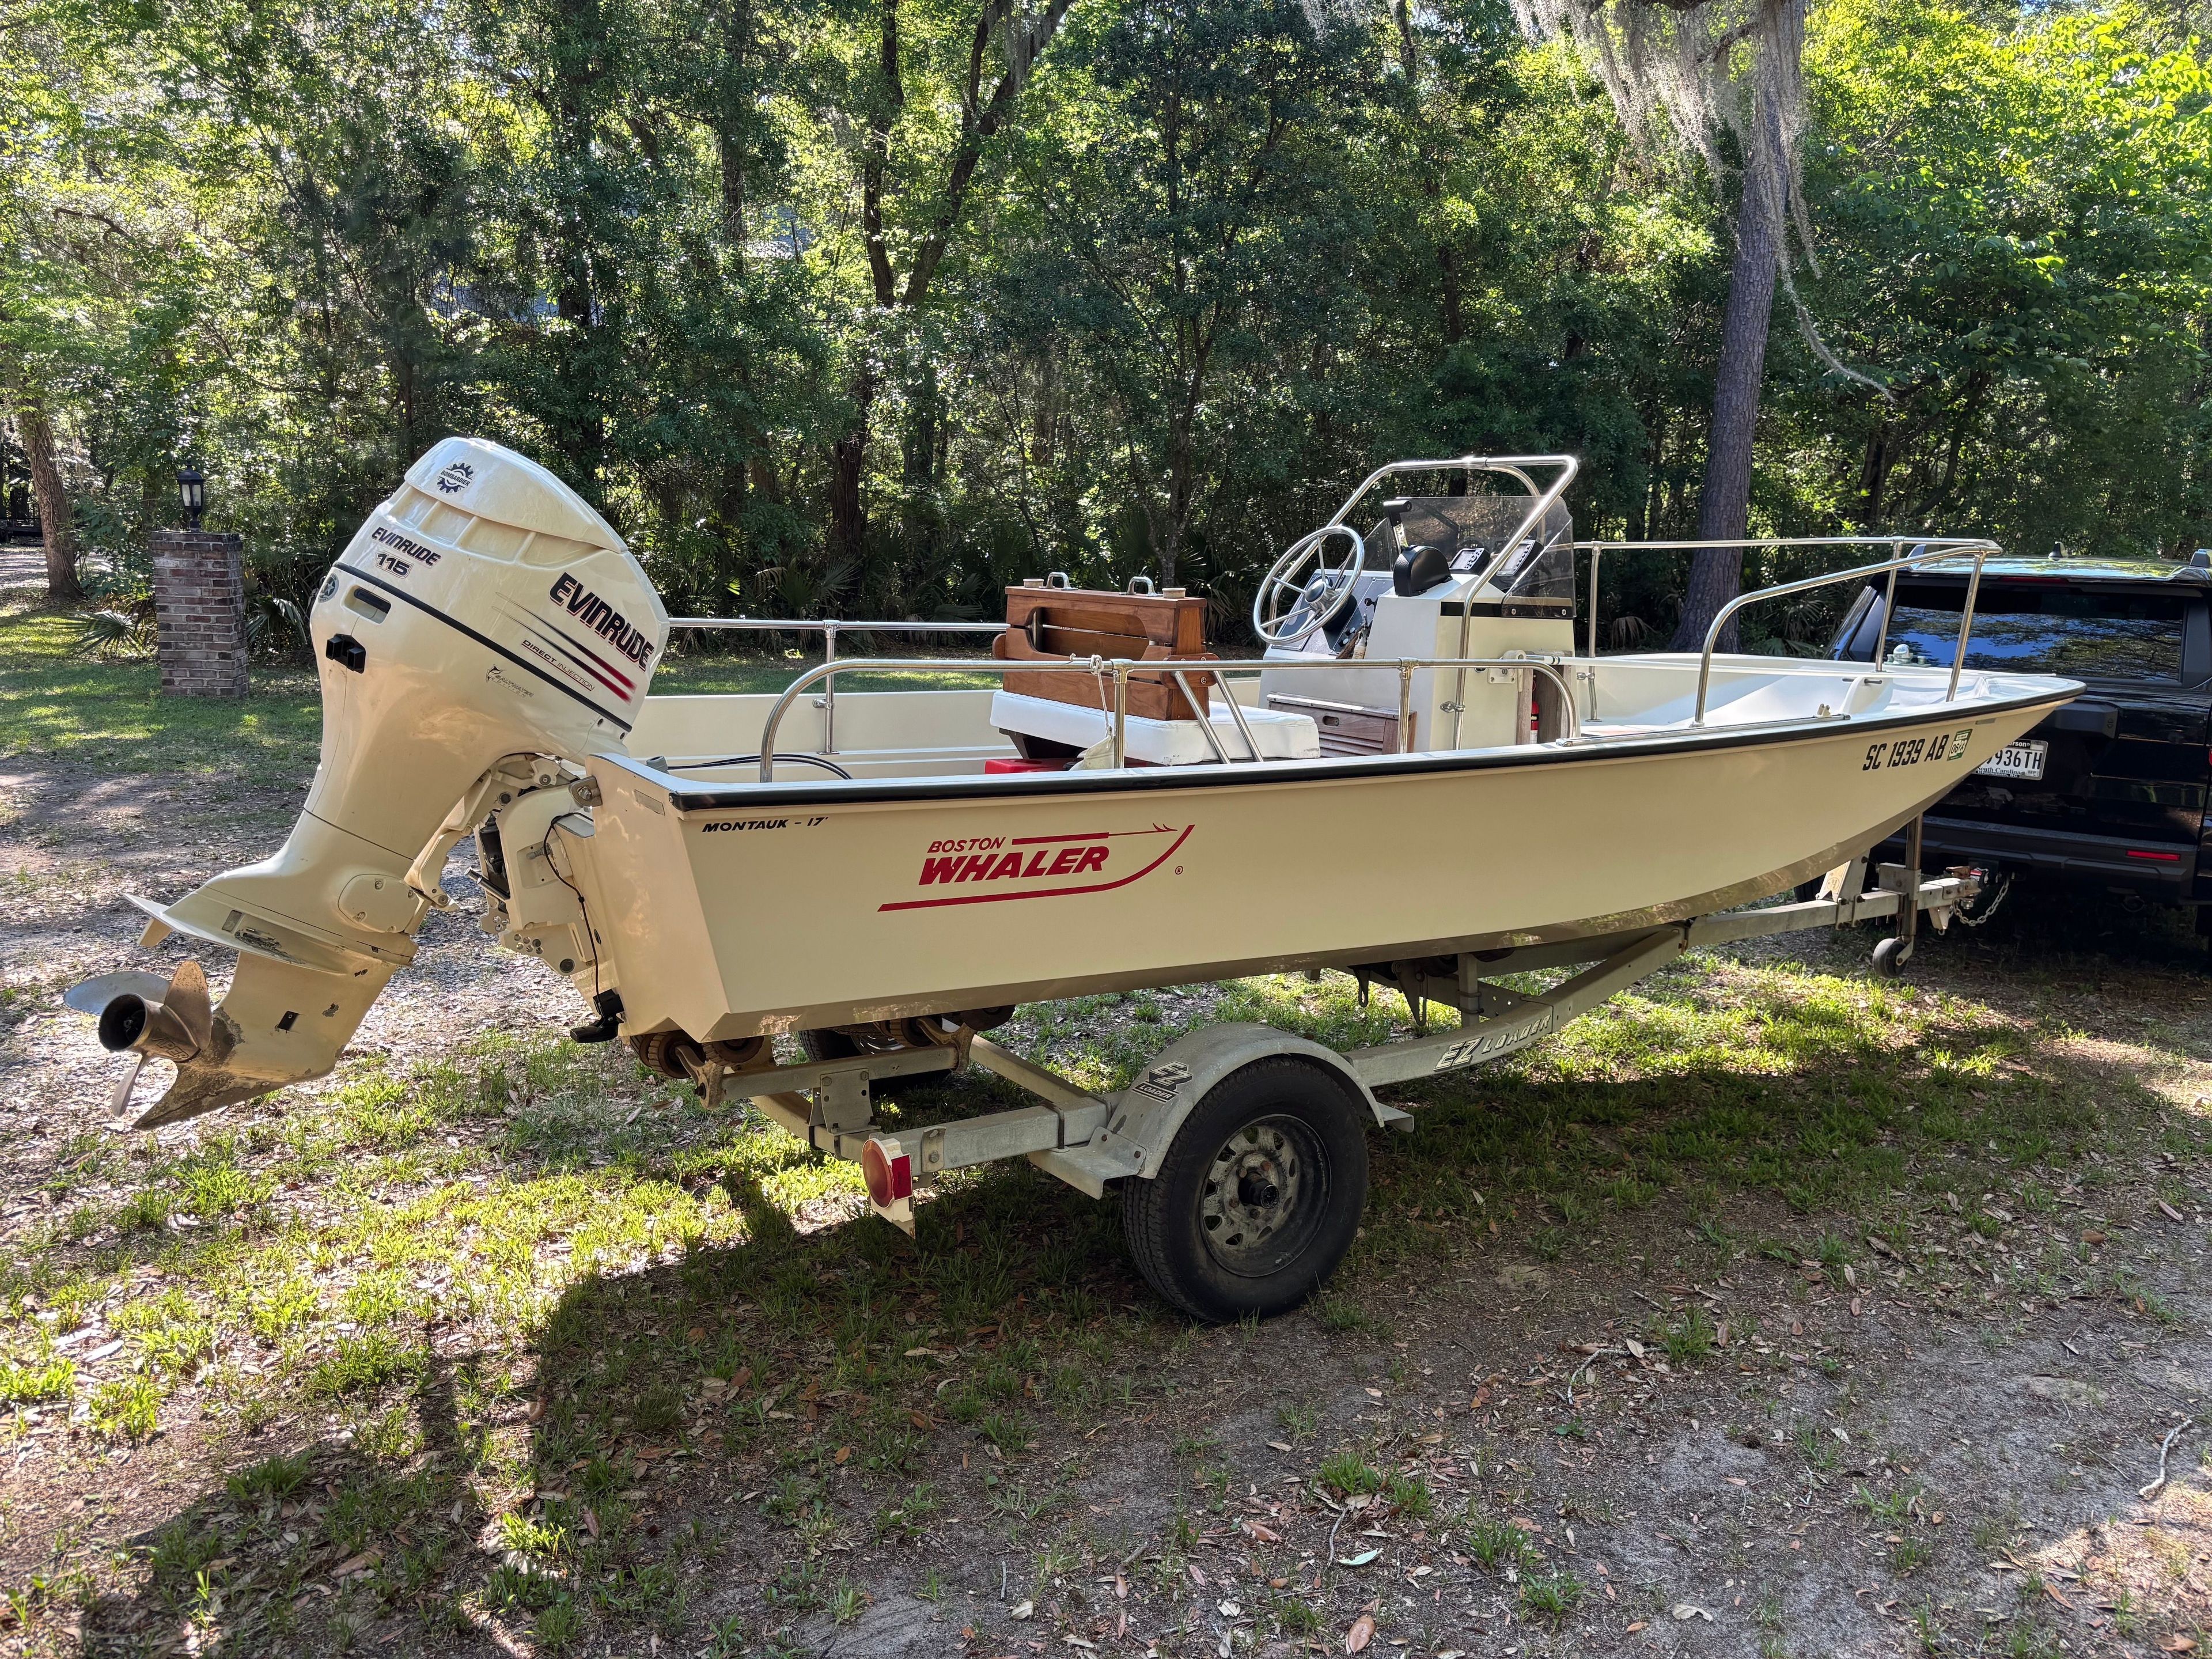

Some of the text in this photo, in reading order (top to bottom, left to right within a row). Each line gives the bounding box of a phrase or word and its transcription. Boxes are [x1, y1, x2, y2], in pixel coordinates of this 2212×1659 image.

[440, 470, 471, 486] BOMBARDIER
[371, 527, 442, 567] EVINRUDE
[377, 553, 410, 576] 115
[550, 572, 654, 672] EVINRUDE
[522, 639, 596, 691] DIRECT INJECTION
[1862, 734, 1949, 771] SC 1939 AB
[1995, 767, 2021, 776] Carolina
[702, 819, 789, 832] MONTAUK
[807, 816, 828, 827] 17'
[927, 836, 1006, 854] BOSTON
[918, 846, 1109, 886] WHALER
[1433, 1014, 1551, 1072] EZ LOADER
[1149, 1060, 1193, 1090] EZ
[1139, 1085, 1173, 1099] LOADER
